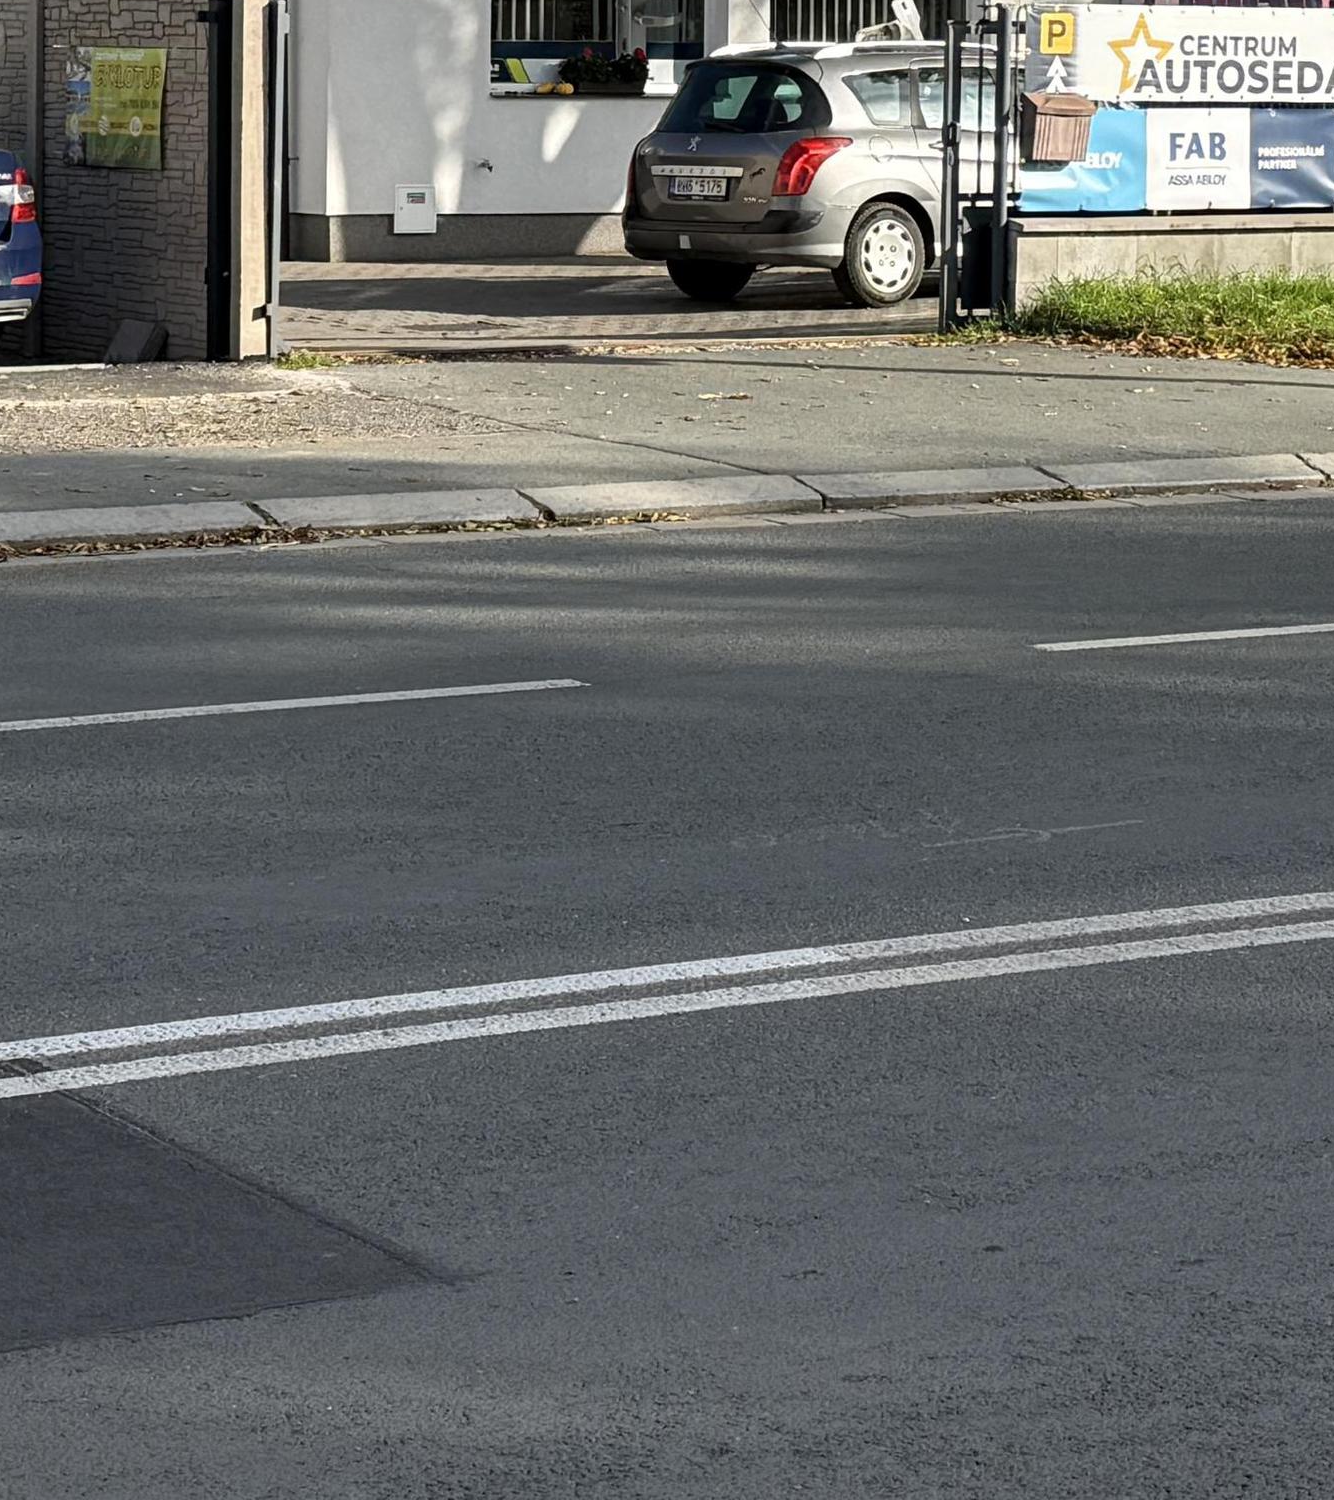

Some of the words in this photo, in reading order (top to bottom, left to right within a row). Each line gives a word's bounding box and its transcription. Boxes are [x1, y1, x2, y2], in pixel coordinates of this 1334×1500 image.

[1048, 20, 1066, 48] P
[1179, 35, 1297, 57] CENTRUM
[1169, 132, 1227, 162] FAB
[698, 180, 723, 194] 5175
[1168, 175, 1194, 186] ASSA
[1196, 175, 1227, 186] ABLOY
